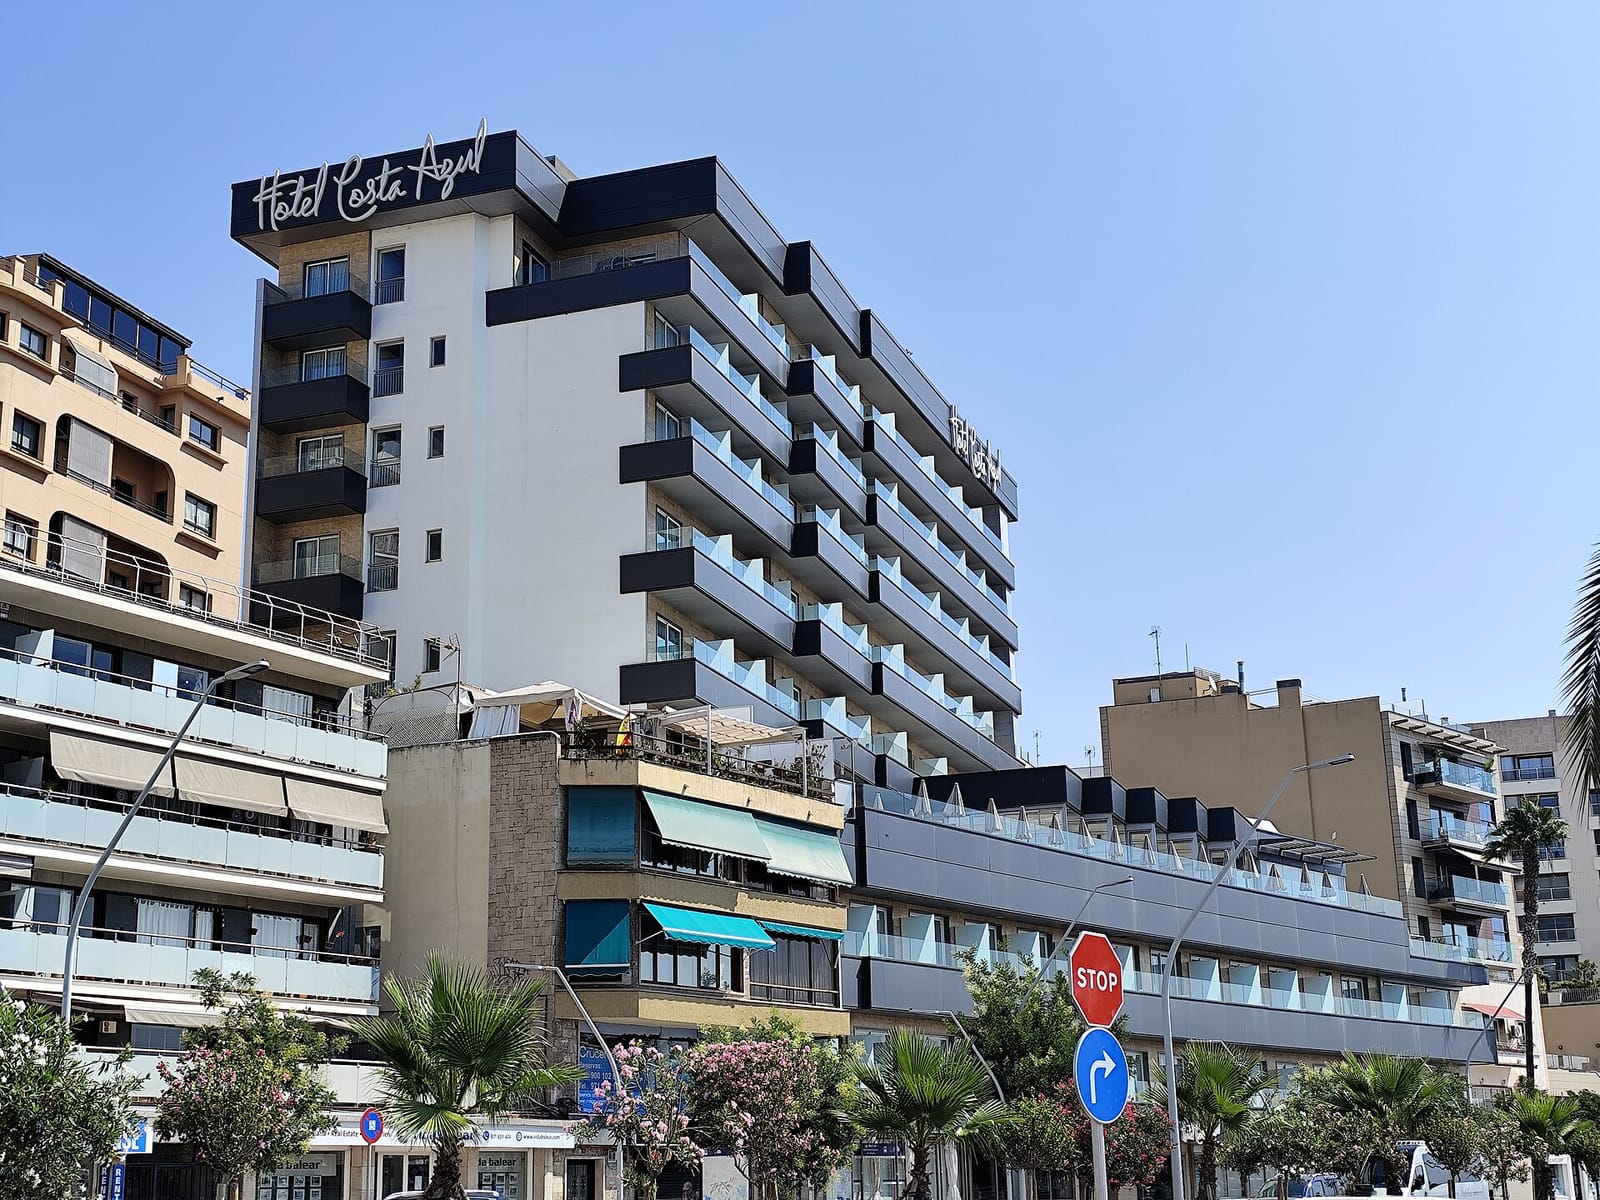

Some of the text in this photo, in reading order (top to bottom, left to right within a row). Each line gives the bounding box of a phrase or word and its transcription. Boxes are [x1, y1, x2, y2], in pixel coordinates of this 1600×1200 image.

[253, 115, 488, 232] Hotel Costa Azul
[950, 404, 969, 457] Hotel
[1077, 966, 1118, 992] STOP
[488, 1157, 517, 1167] balear
